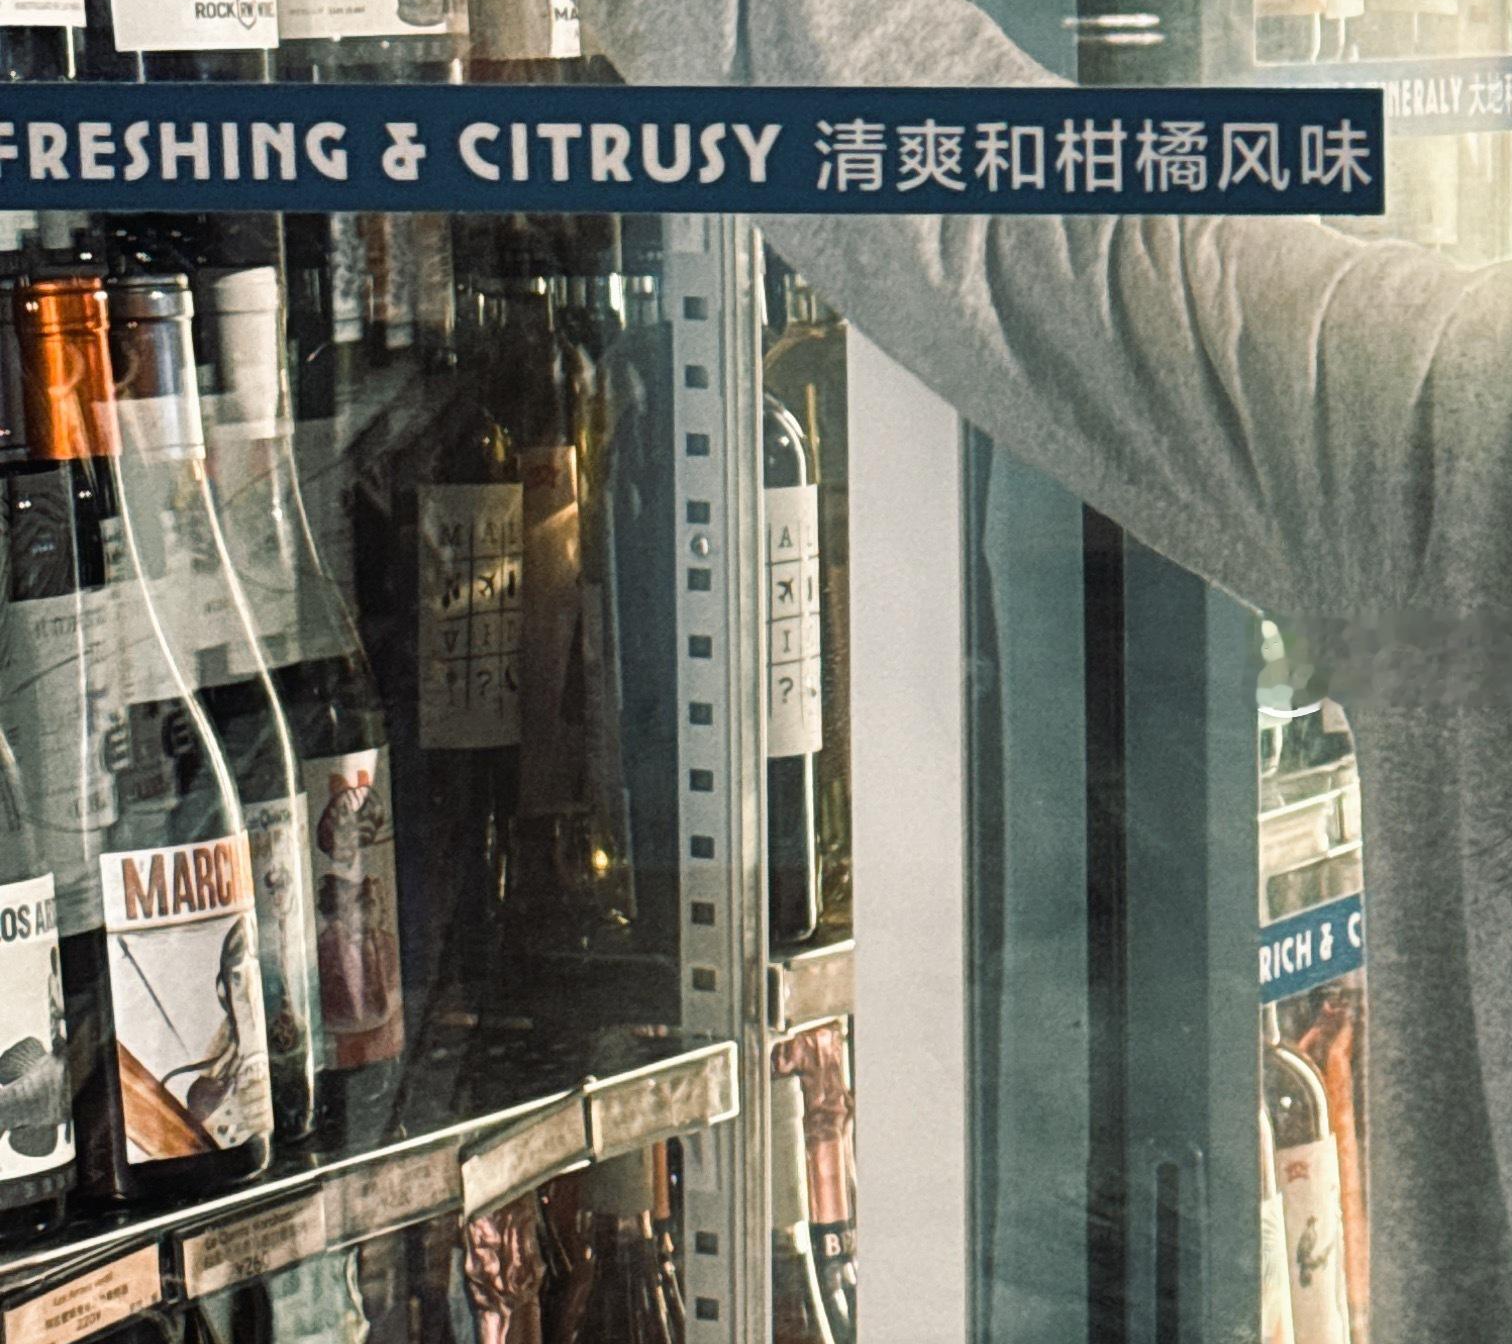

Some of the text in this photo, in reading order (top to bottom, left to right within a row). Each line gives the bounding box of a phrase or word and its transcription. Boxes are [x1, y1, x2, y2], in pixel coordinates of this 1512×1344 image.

[194, 1, 236, 19] ROCK
[381, 122, 426, 182] &
[457, 120, 781, 184] CITRUSY
[814, 118, 1373, 194] 清爽和柑橘风味
[121, 842, 238, 921] MARC
[0, 904, 32, 943] OS
[1259, 928, 1312, 985] RICH
[1319, 922, 1334, 961] &
